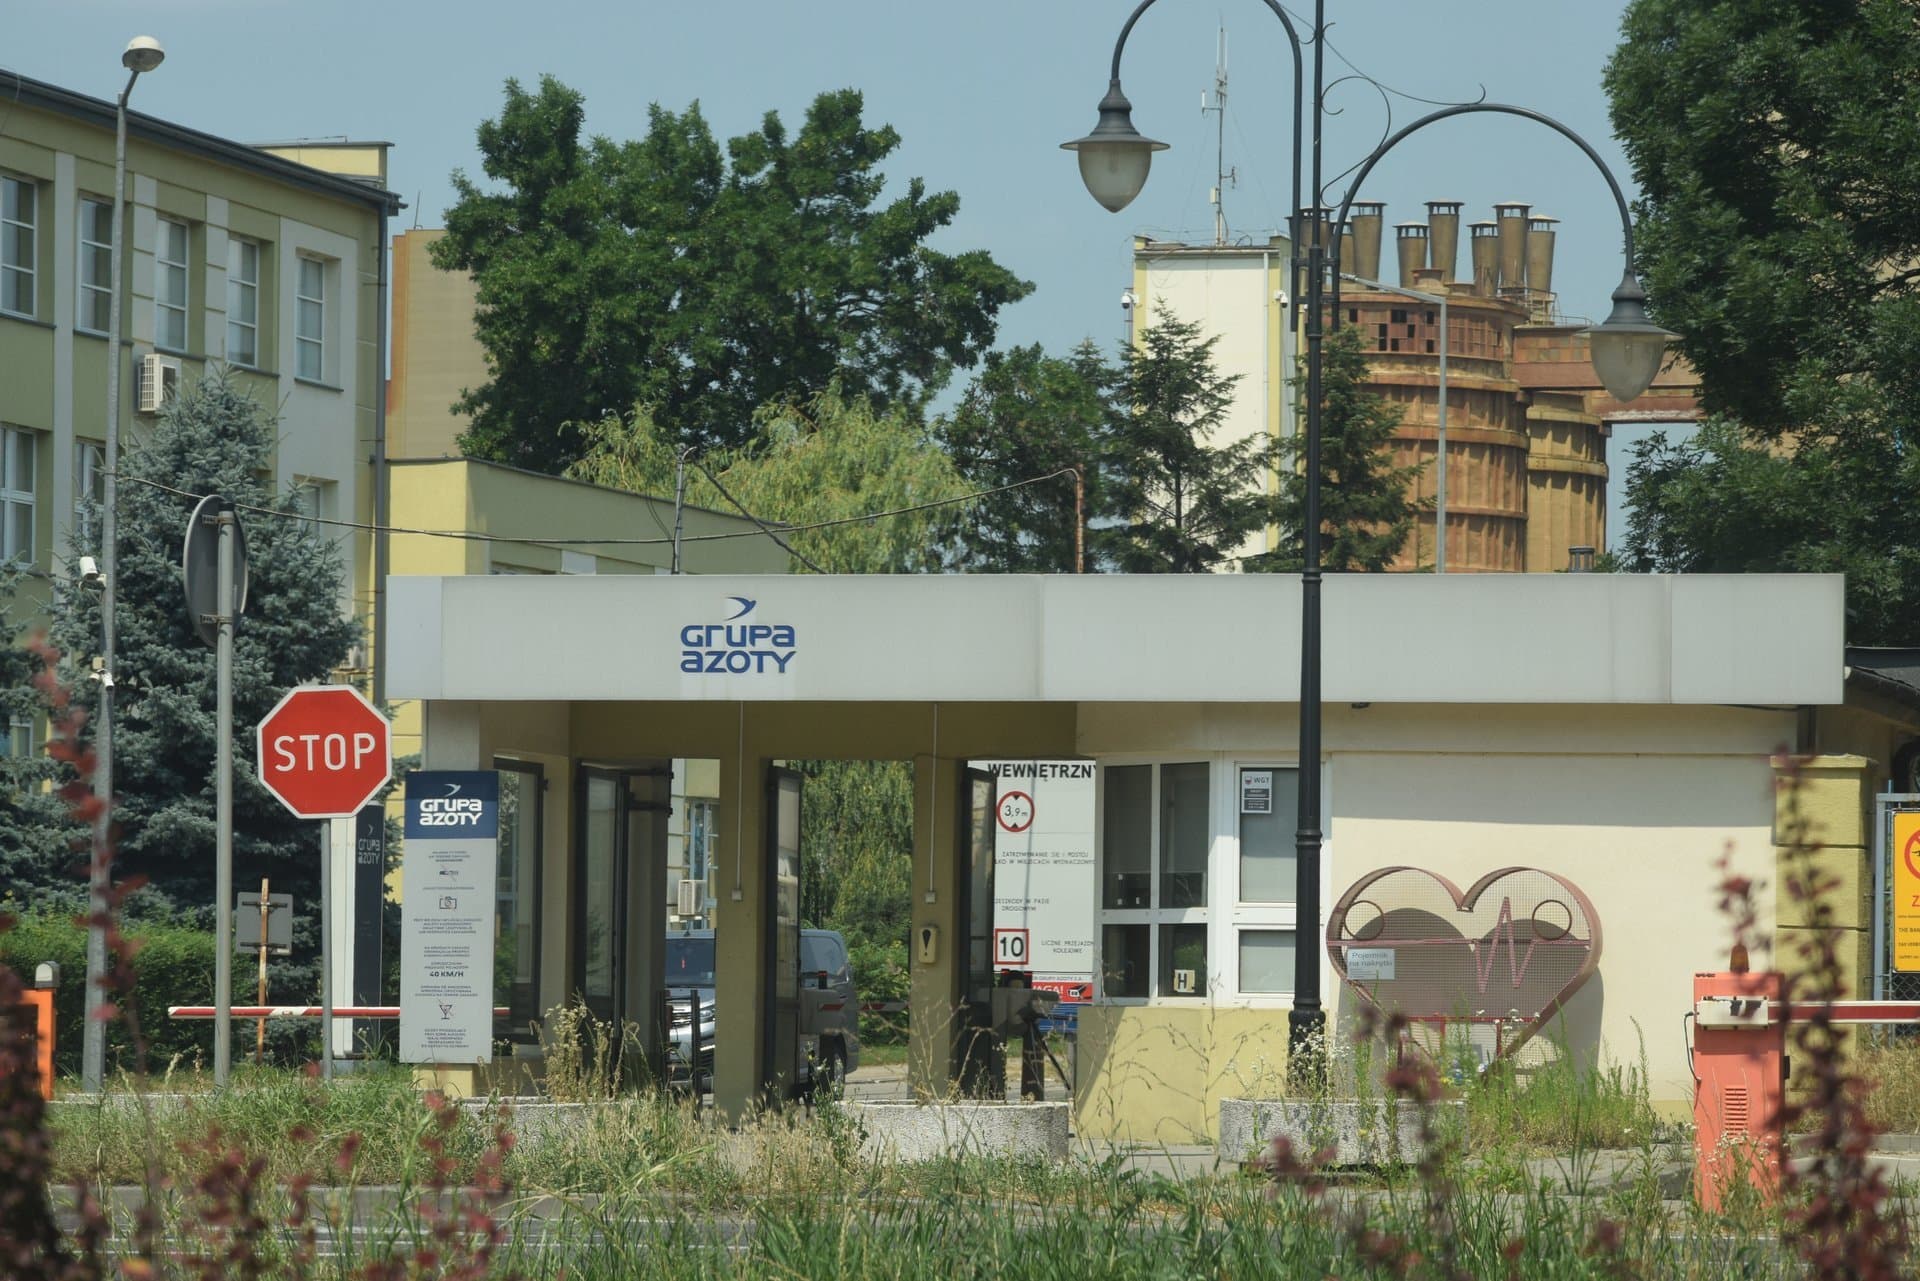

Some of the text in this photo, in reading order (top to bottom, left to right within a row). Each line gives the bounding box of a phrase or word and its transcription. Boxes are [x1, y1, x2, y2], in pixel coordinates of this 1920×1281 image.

[274, 732, 376, 771] STOP
[988, 763, 1096, 782] WEWNĘTRZN
[1000, 936, 1024, 957] 10
